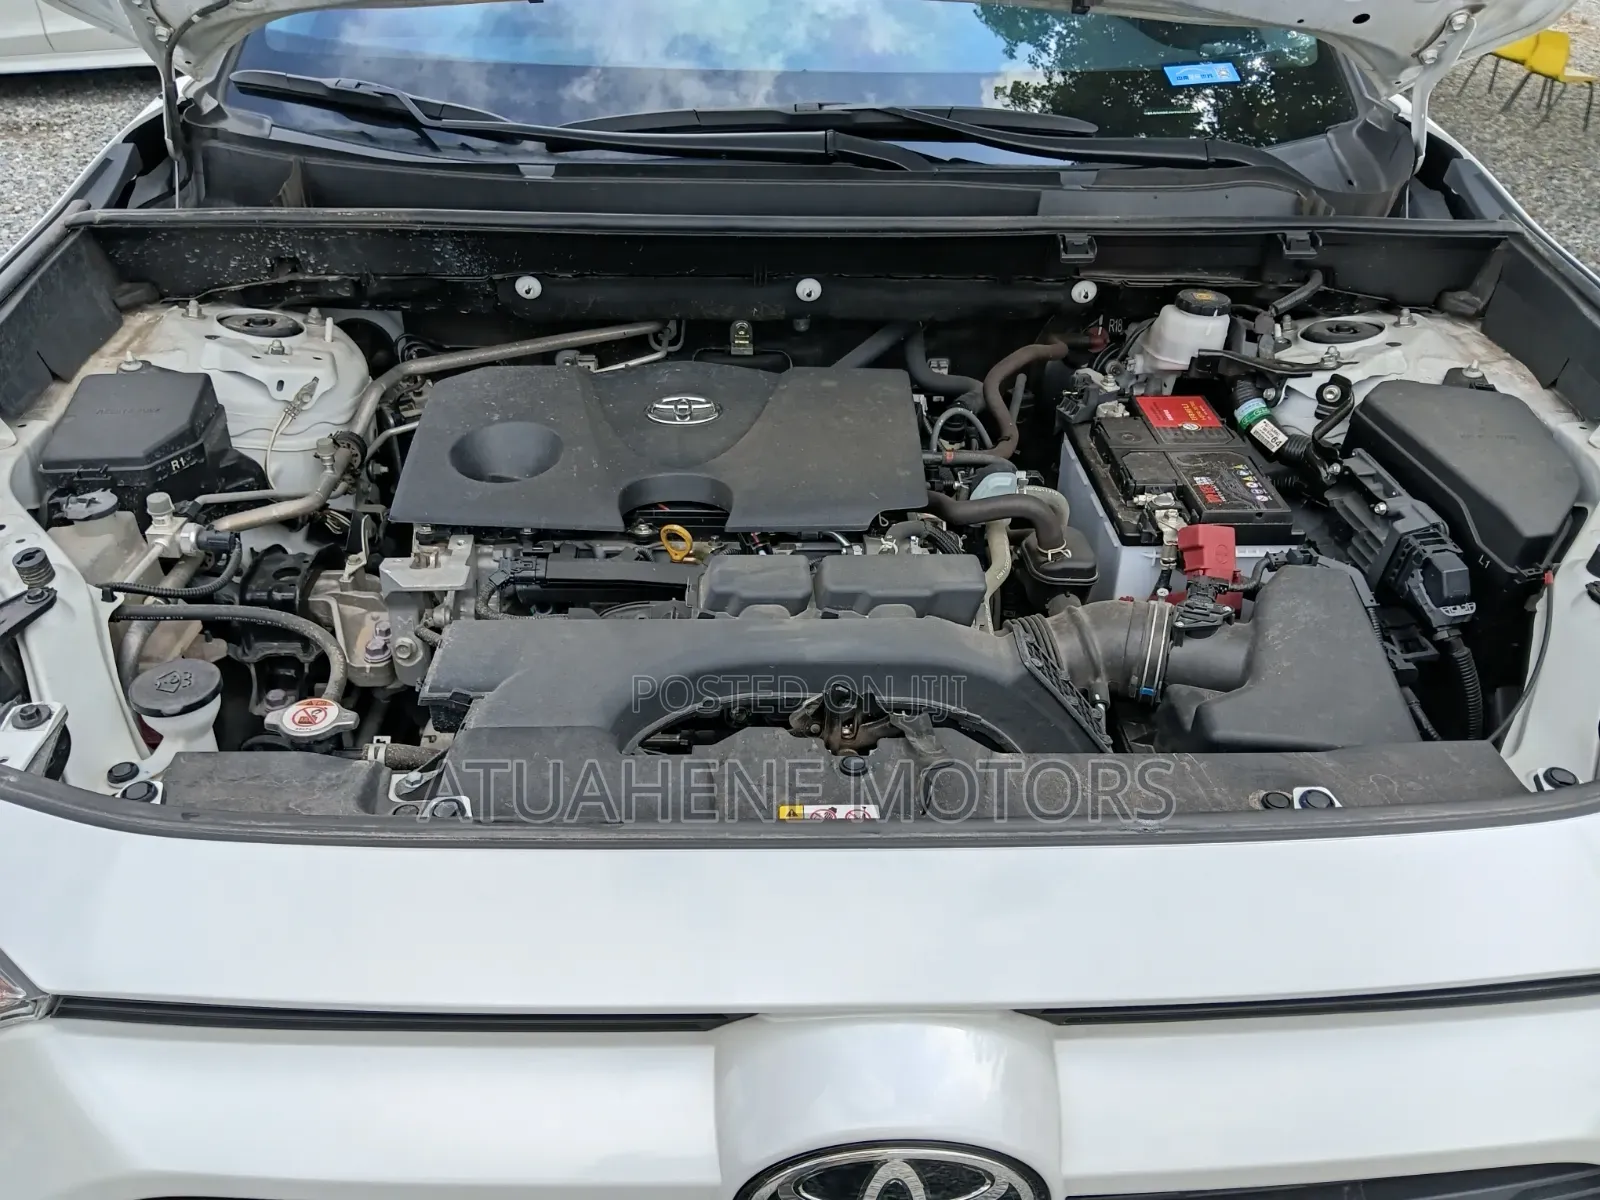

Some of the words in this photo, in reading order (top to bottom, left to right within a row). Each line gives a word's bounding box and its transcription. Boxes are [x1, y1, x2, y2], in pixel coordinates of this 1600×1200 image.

[1108, 318, 1123, 333] R18
[1270, 436, 1283, 448] 64
[171, 457, 187, 471] R1
[1478, 554, 1491, 569] L1
